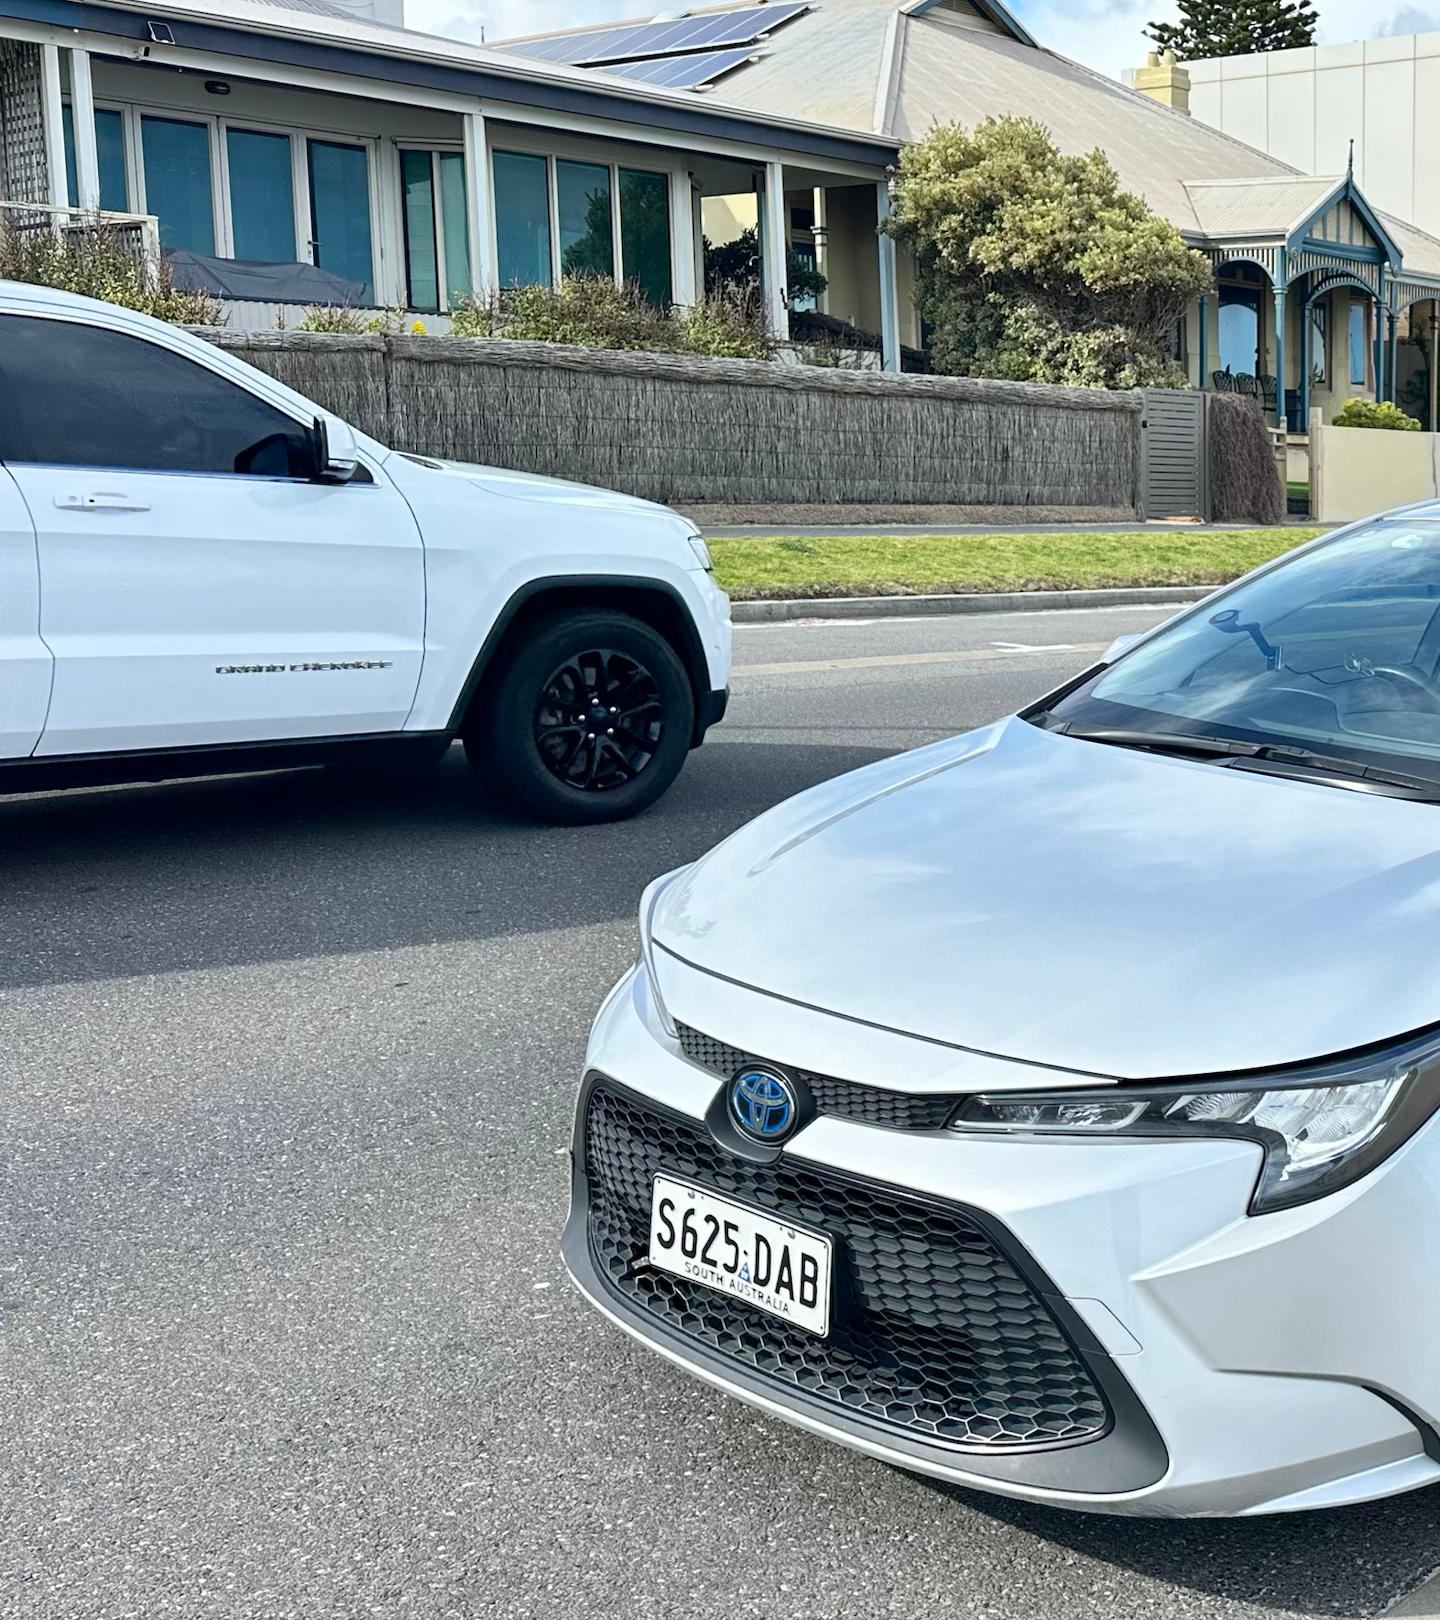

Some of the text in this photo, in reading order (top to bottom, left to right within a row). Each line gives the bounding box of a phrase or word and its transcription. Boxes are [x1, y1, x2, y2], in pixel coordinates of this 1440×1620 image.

[215, 661, 393, 674] GRAND CHEROKEE
[685, 1261, 790, 1315] SOUTH AUSTRALIA
